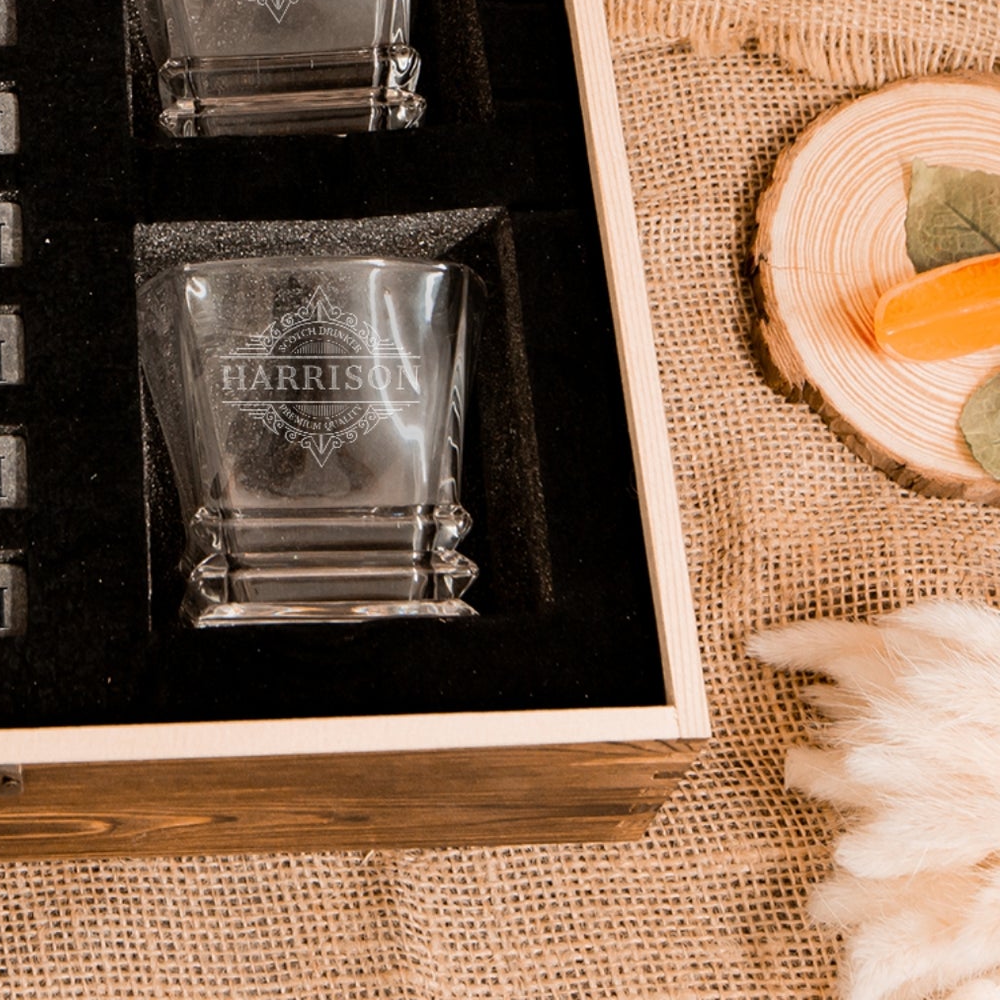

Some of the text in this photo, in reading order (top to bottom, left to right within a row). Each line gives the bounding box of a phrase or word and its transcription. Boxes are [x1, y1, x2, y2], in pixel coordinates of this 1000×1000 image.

[279, 326, 363, 354] SCOTCH DRINKER
[222, 364, 422, 391] HARRISON
[279, 404, 363, 431] PREMIUM QUALITY
